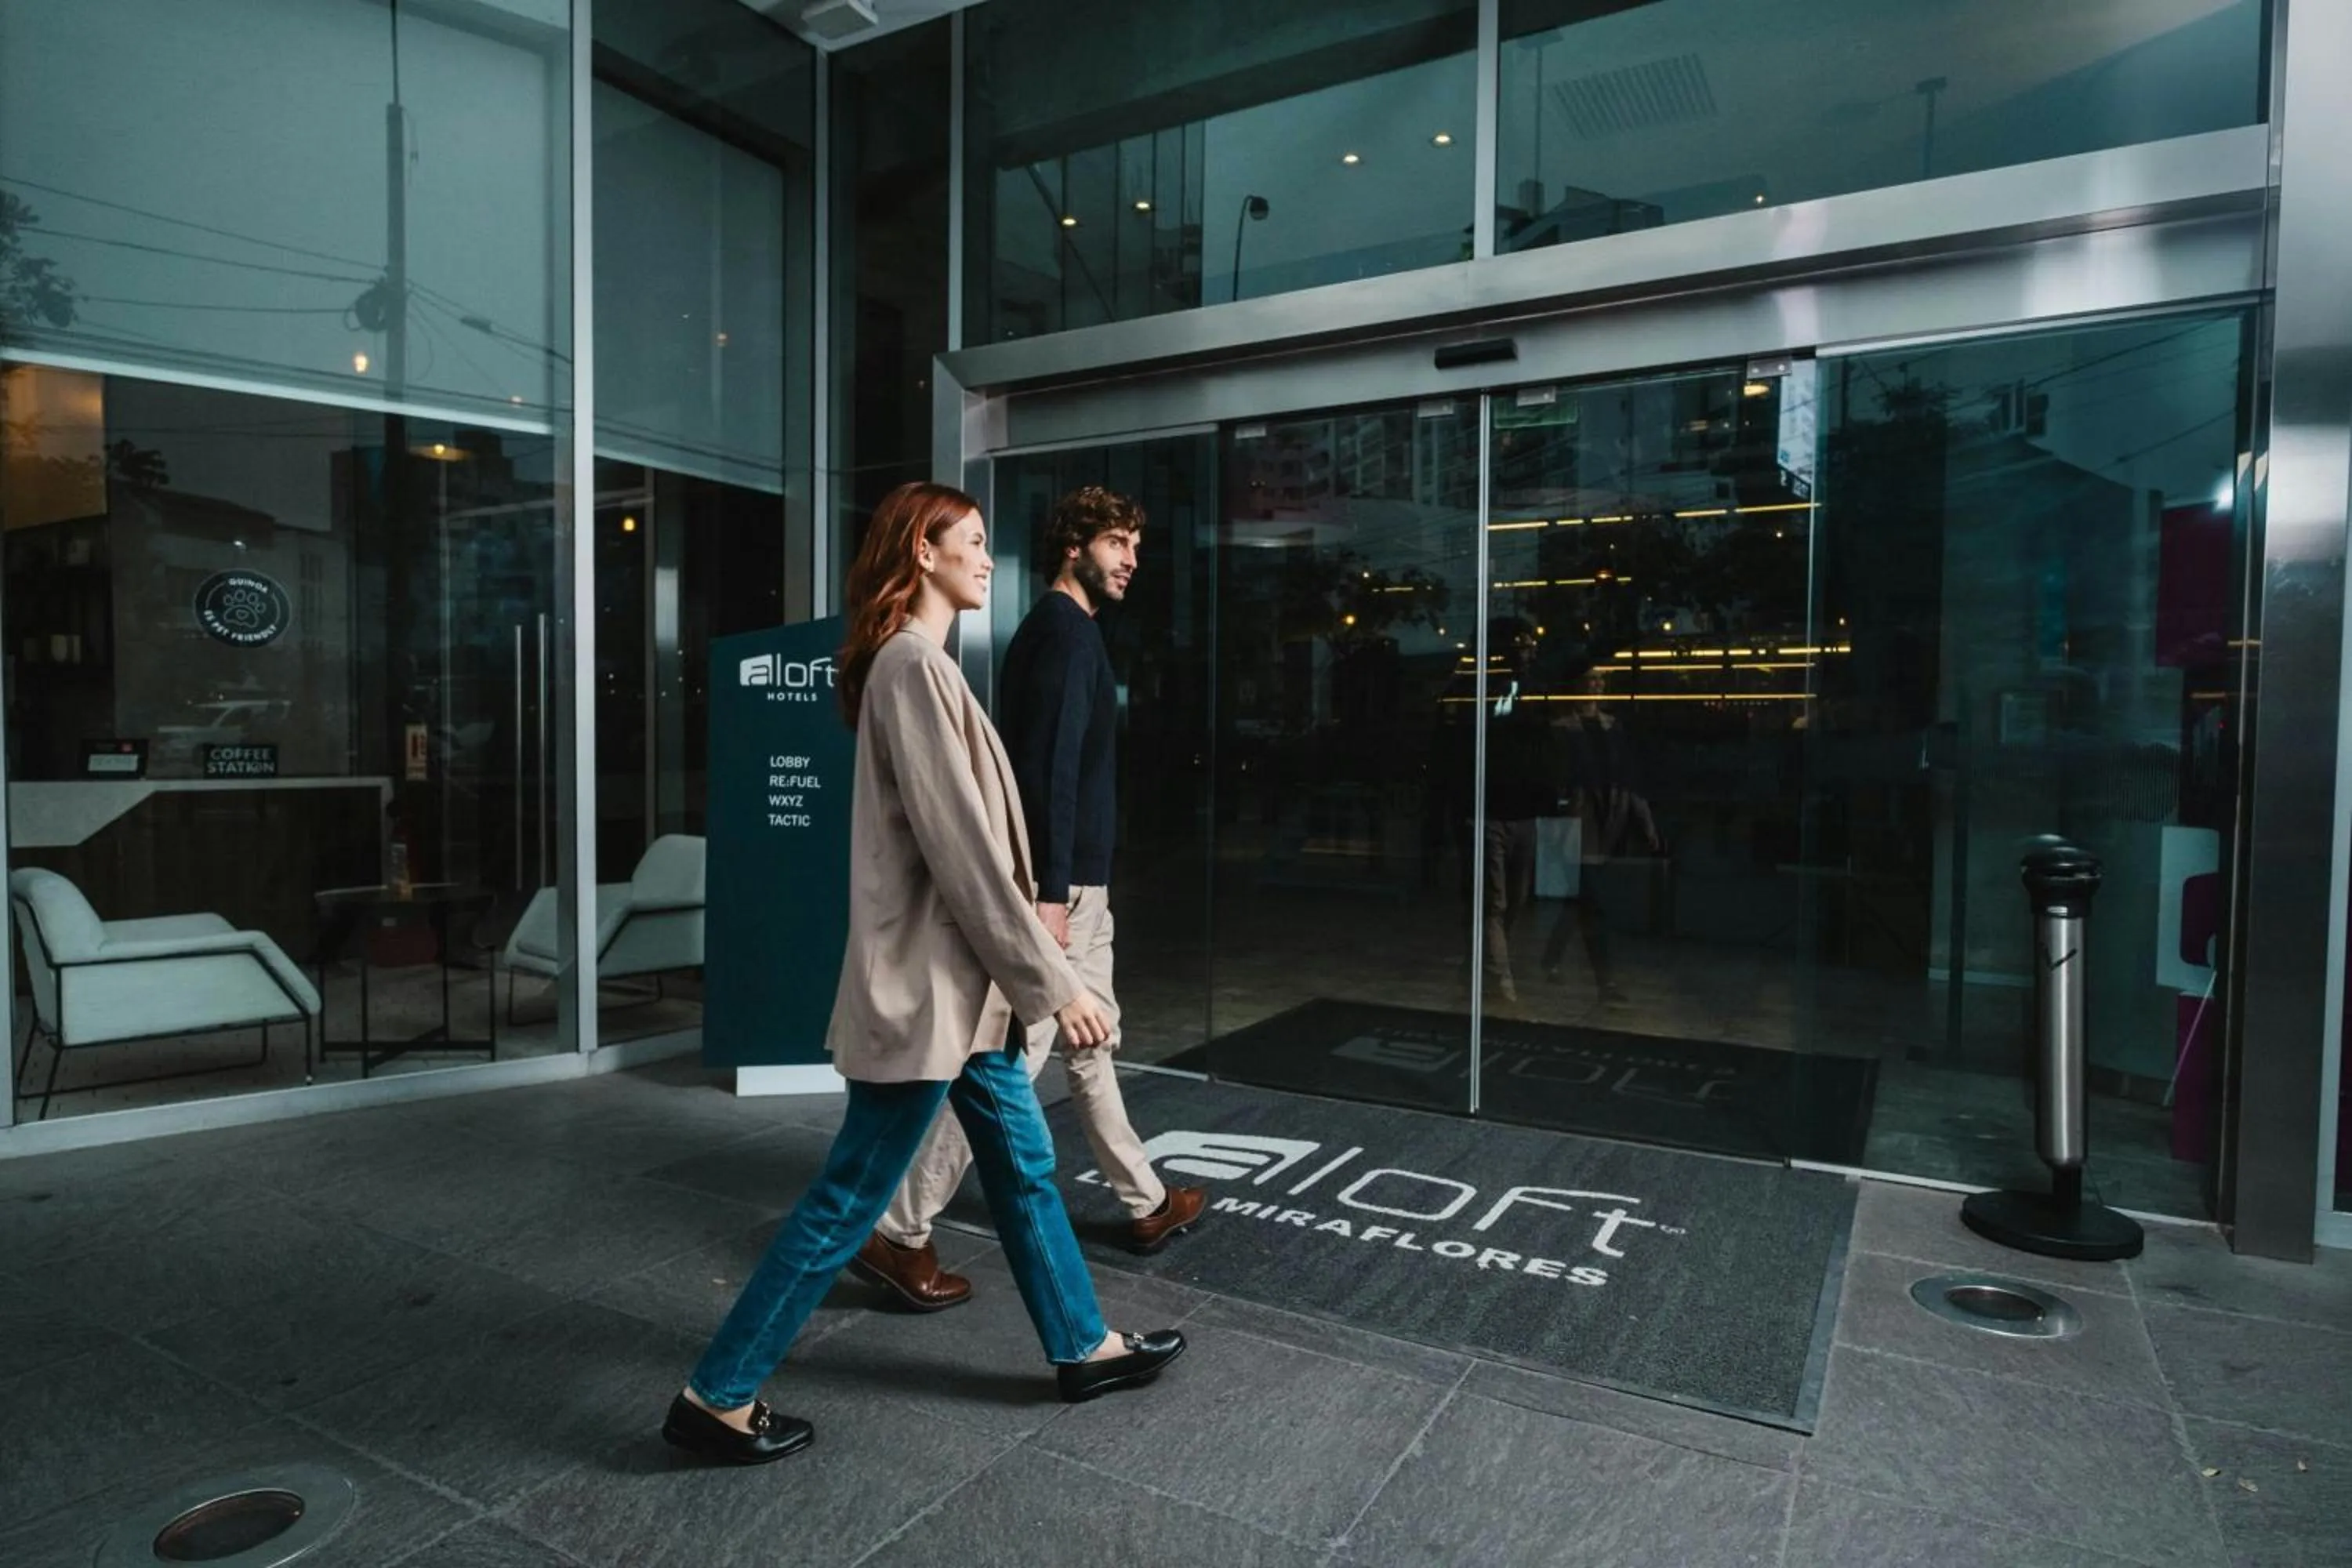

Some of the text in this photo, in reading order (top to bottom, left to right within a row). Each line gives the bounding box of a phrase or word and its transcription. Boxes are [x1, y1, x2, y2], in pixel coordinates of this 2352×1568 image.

[230, 624, 277, 642] FRIENDLY
[739, 652, 840, 688] aloft
[767, 692, 818, 702] HOTELS
[209, 747, 271, 760] COFFEE
[206, 761, 275, 775] STATION
[770, 756, 811, 768] LOBBY
[769, 775, 821, 789] RE:FUEL
[768, 795, 804, 808] WXYZ
[768, 814, 811, 827] TACTIC
[1142, 1130, 1657, 1258] aloft
[1211, 1196, 1609, 1287] MIRAFLORES
